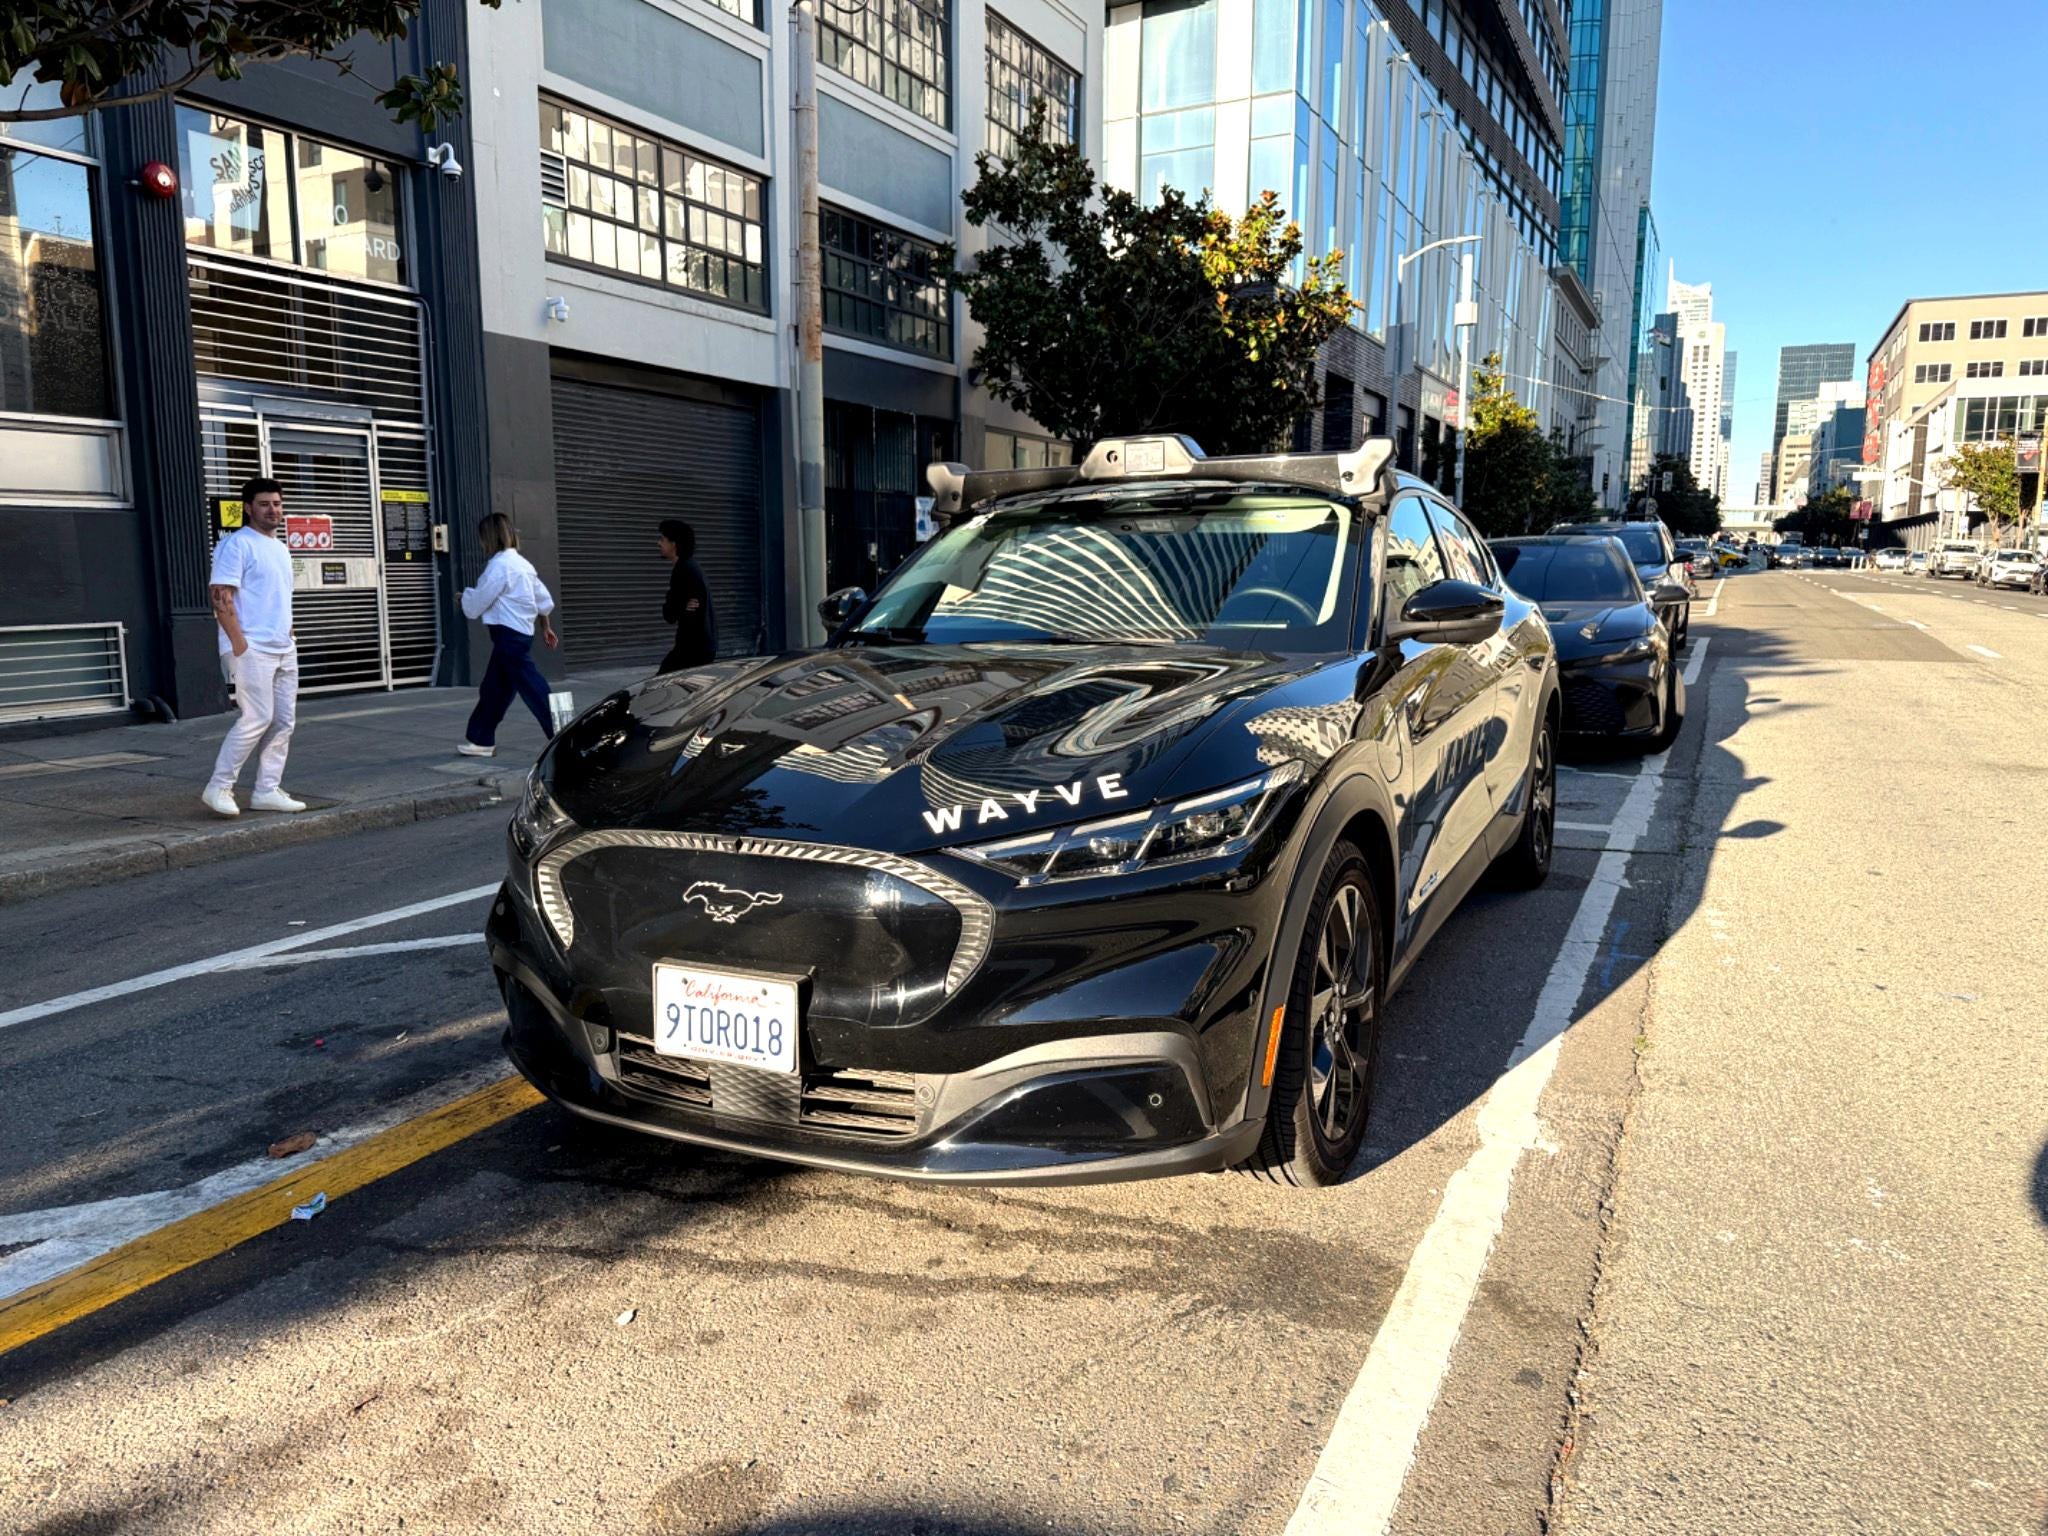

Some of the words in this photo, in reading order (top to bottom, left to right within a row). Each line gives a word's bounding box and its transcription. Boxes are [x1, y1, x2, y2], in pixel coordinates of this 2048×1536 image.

[1434, 716, 1489, 795] WAYVE
[922, 773, 1129, 834] WAYVE
[684, 979, 769, 1007] California
